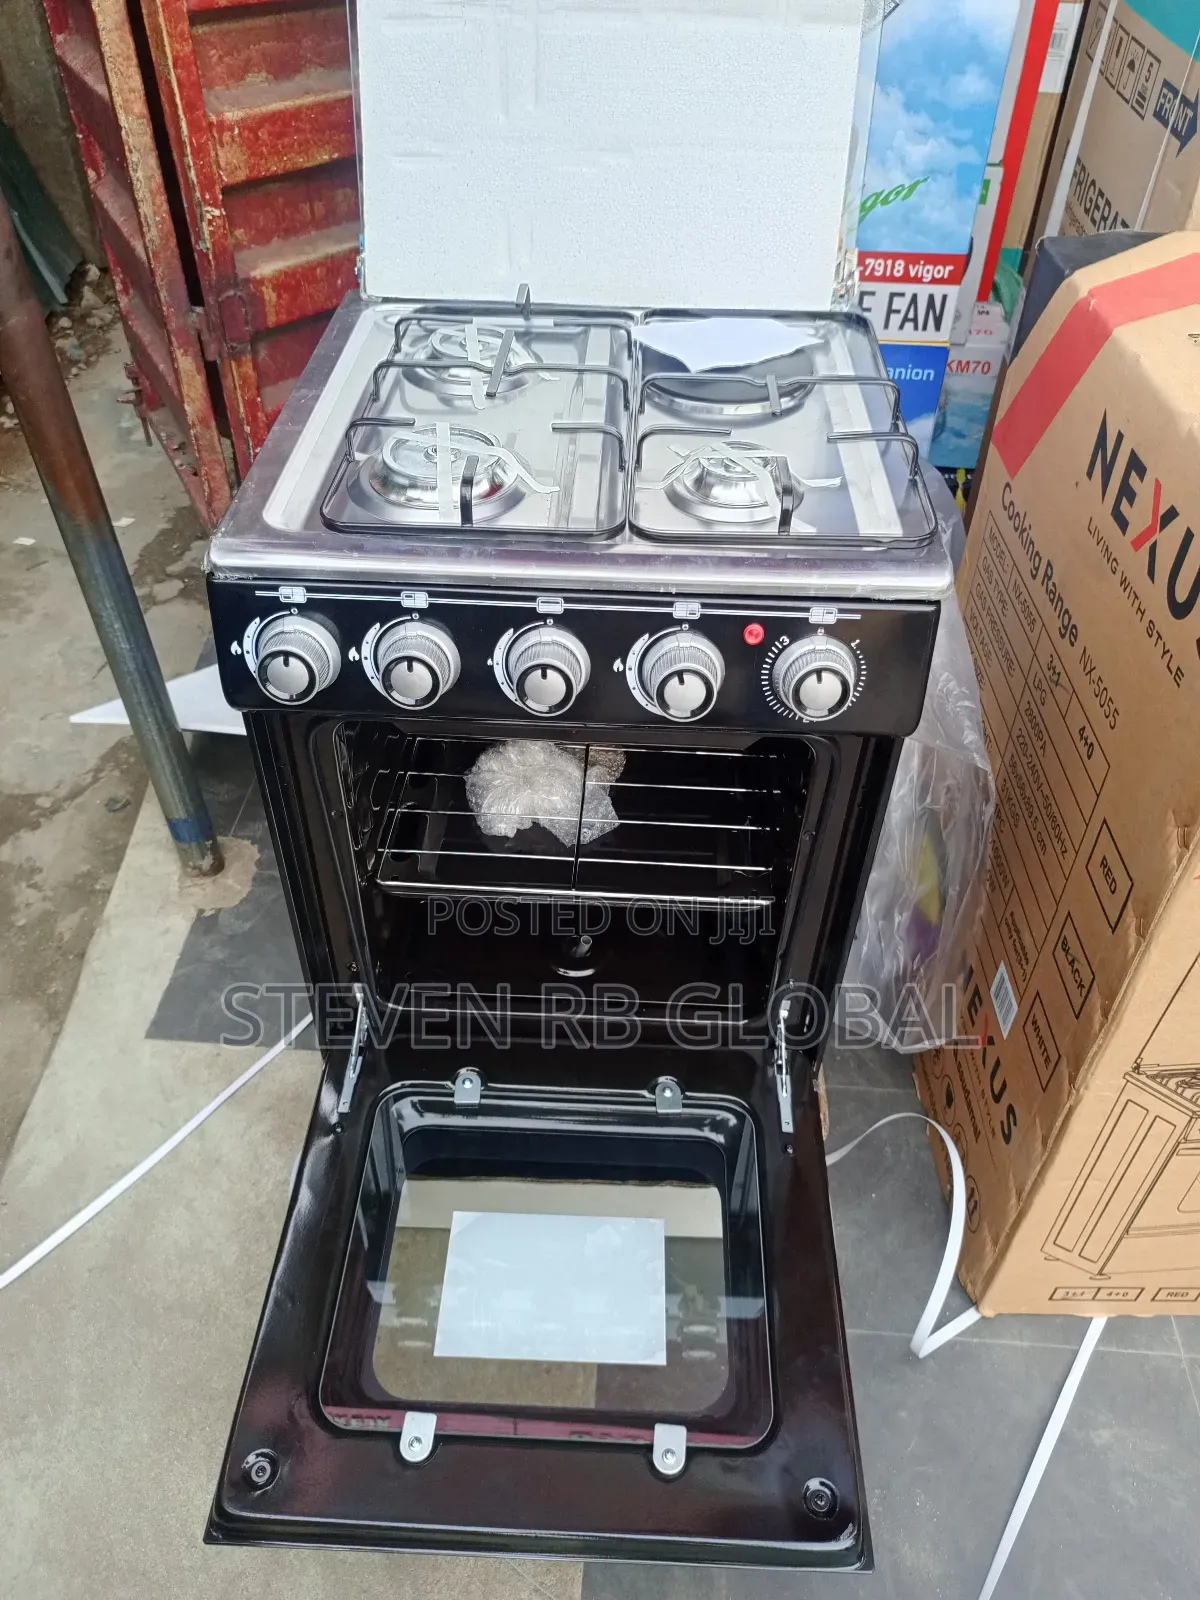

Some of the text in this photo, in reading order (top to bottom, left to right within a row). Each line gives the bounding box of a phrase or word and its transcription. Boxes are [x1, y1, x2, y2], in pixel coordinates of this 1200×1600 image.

[1156, 87, 1194, 136] FRONT
[908, 260, 954, 283] vigor
[883, 291, 948, 333] FAN
[1086, 408, 1200, 660] NEXU
[975, 582, 987, 607] GAS
[985, 604, 1016, 679] PRESSURE:
[982, 555, 1047, 707] GAS TYPE: LPG
[1001, 481, 1120, 731] Cooking Range NX-5055
[1087, 516, 1186, 689] LIVING WITH STYLE
[779, 635, 791, 647] 3
[1012, 578, 1037, 634] NX-5055
[1078, 725, 1095, 761] 4+0
[1099, 854, 1118, 896] RED
[1061, 934, 1086, 998] BLACK
[1031, 1012, 1052, 1071] WHITE
[1165, 1290, 1190, 1299] RED
